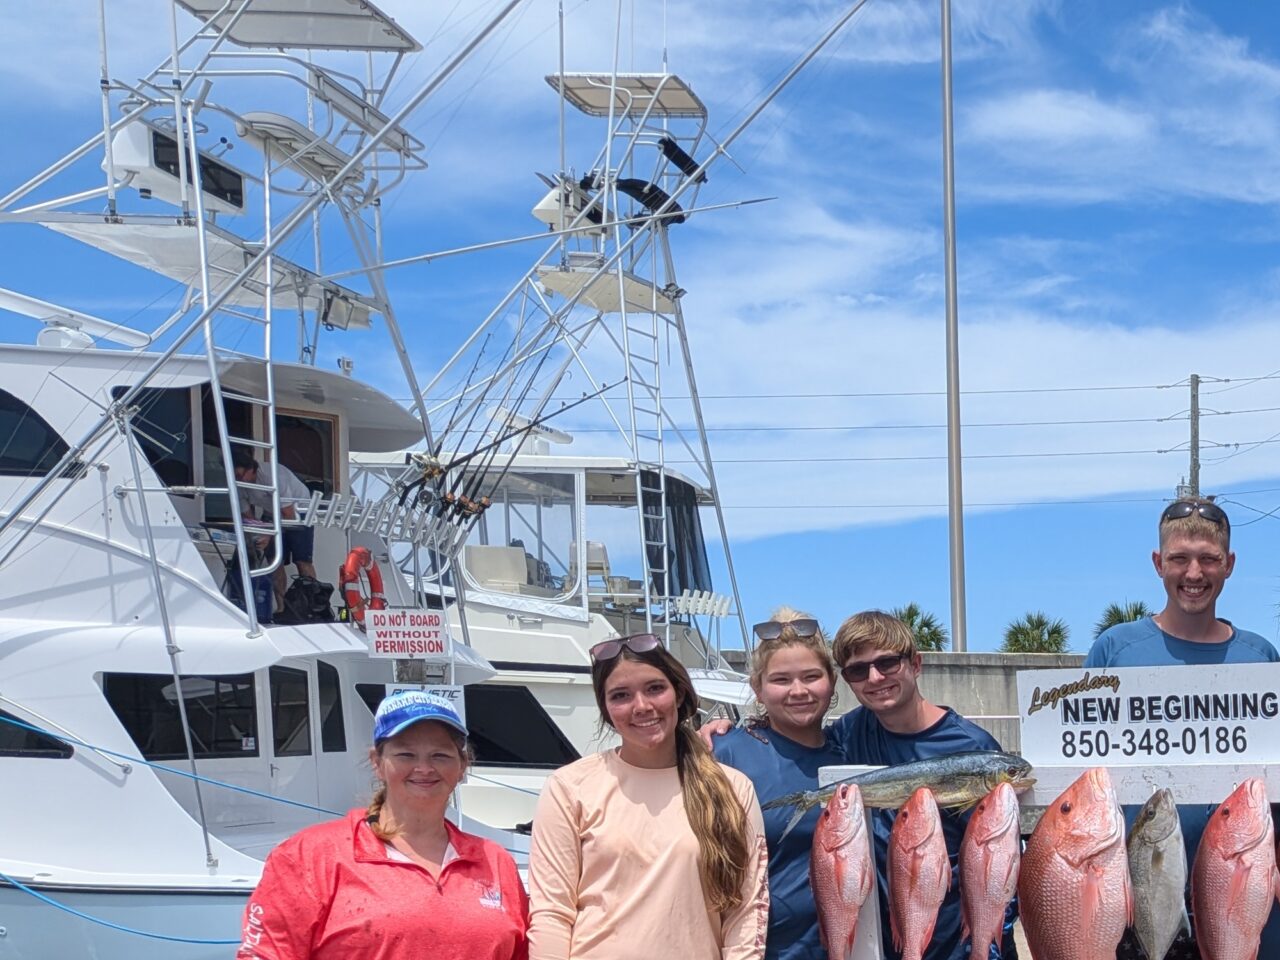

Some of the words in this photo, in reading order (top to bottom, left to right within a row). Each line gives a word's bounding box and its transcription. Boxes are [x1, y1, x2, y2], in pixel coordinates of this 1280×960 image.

[373, 614, 386, 627] DO
[389, 614, 407, 627] NOT
[410, 614, 440, 627] BOARD
[375, 630, 440, 639] WITHOUT
[375, 640, 444, 653] PERMISSION
[1028, 671, 1121, 716] Legendary
[1061, 697, 1121, 725] NEW
[1128, 692, 1279, 723] BEGINNING
[1062, 726, 1248, 758] 850-348-0186
